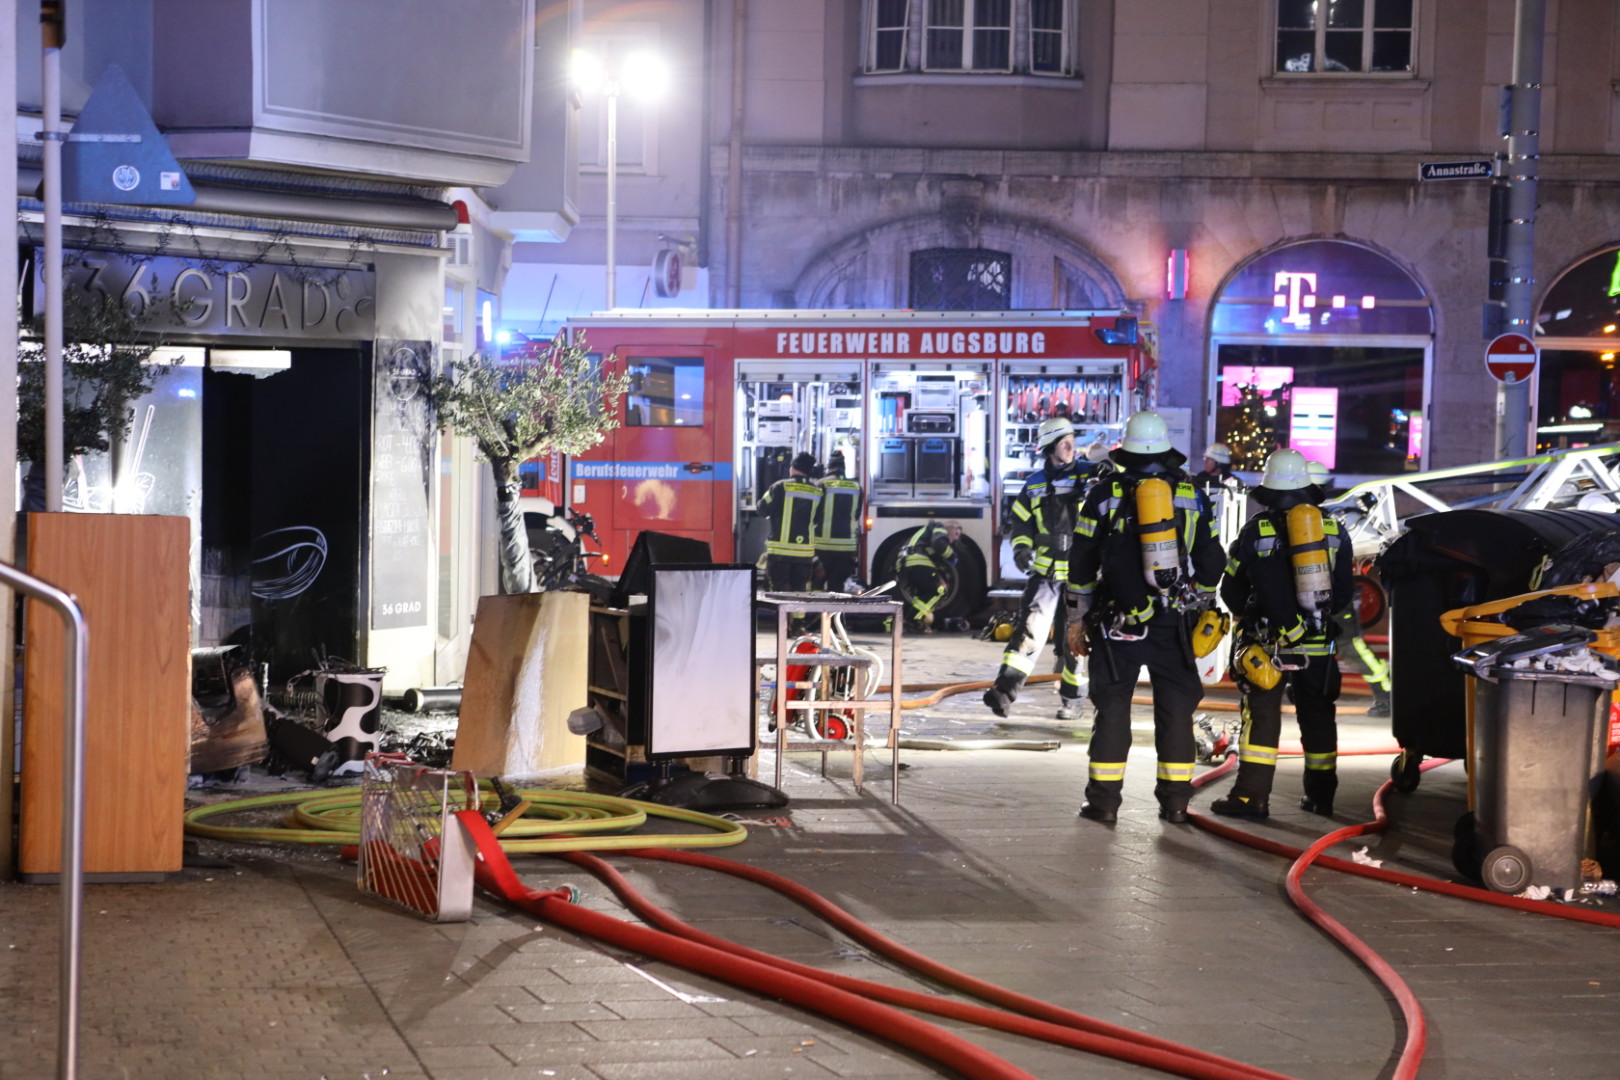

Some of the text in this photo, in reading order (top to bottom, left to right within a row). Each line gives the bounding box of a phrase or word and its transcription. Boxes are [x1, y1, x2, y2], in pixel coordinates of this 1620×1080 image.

[1427, 163, 1487, 177] Annastraße
[82, 259, 331, 330] 36 GRAD
[776, 332, 1046, 354] FEUERWEHR AUGSBURG
[576, 463, 679, 478] Berufsfeuerwehr
[382, 601, 421, 615] 36 GRAD
